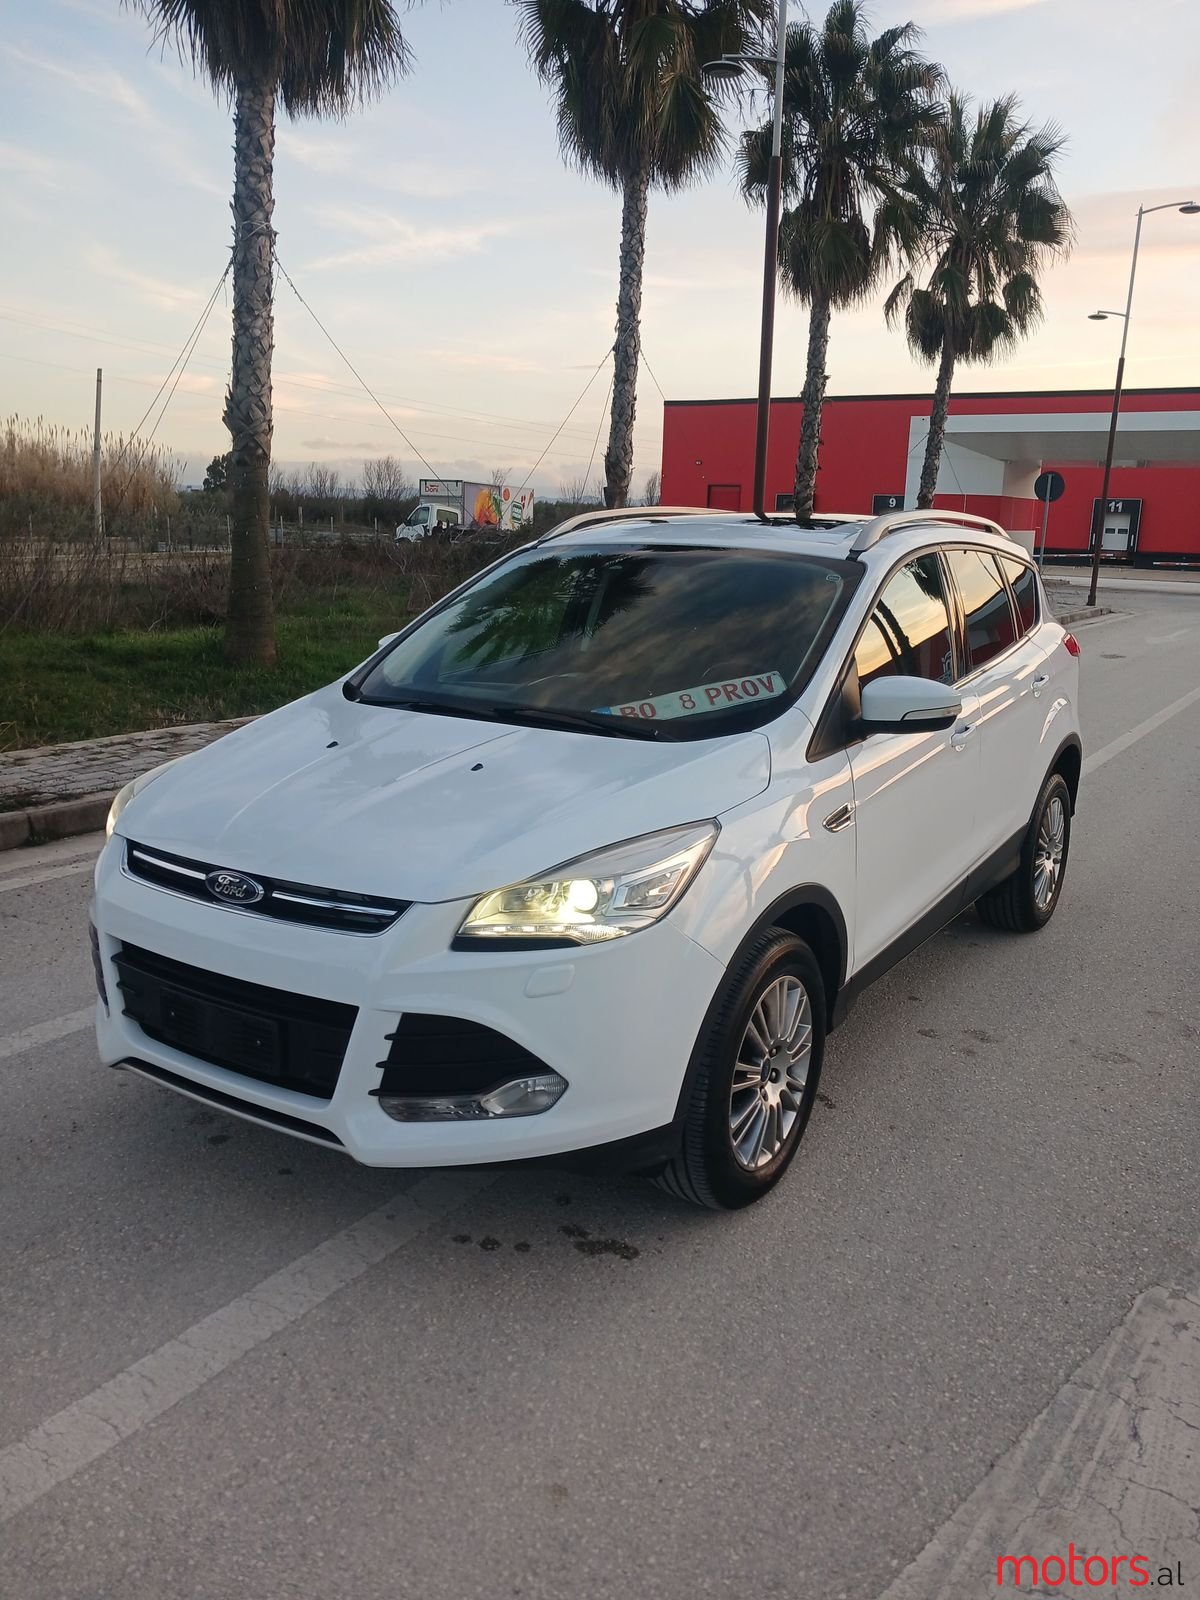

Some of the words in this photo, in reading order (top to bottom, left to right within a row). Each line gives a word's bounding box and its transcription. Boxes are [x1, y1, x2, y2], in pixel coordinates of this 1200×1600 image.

[888, 497, 896, 507] 9
[1109, 501, 1122, 512] 11
[679, 694, 696, 709] 8
[705, 675, 774, 705] PROV
[214, 875, 247, 897] Ford
